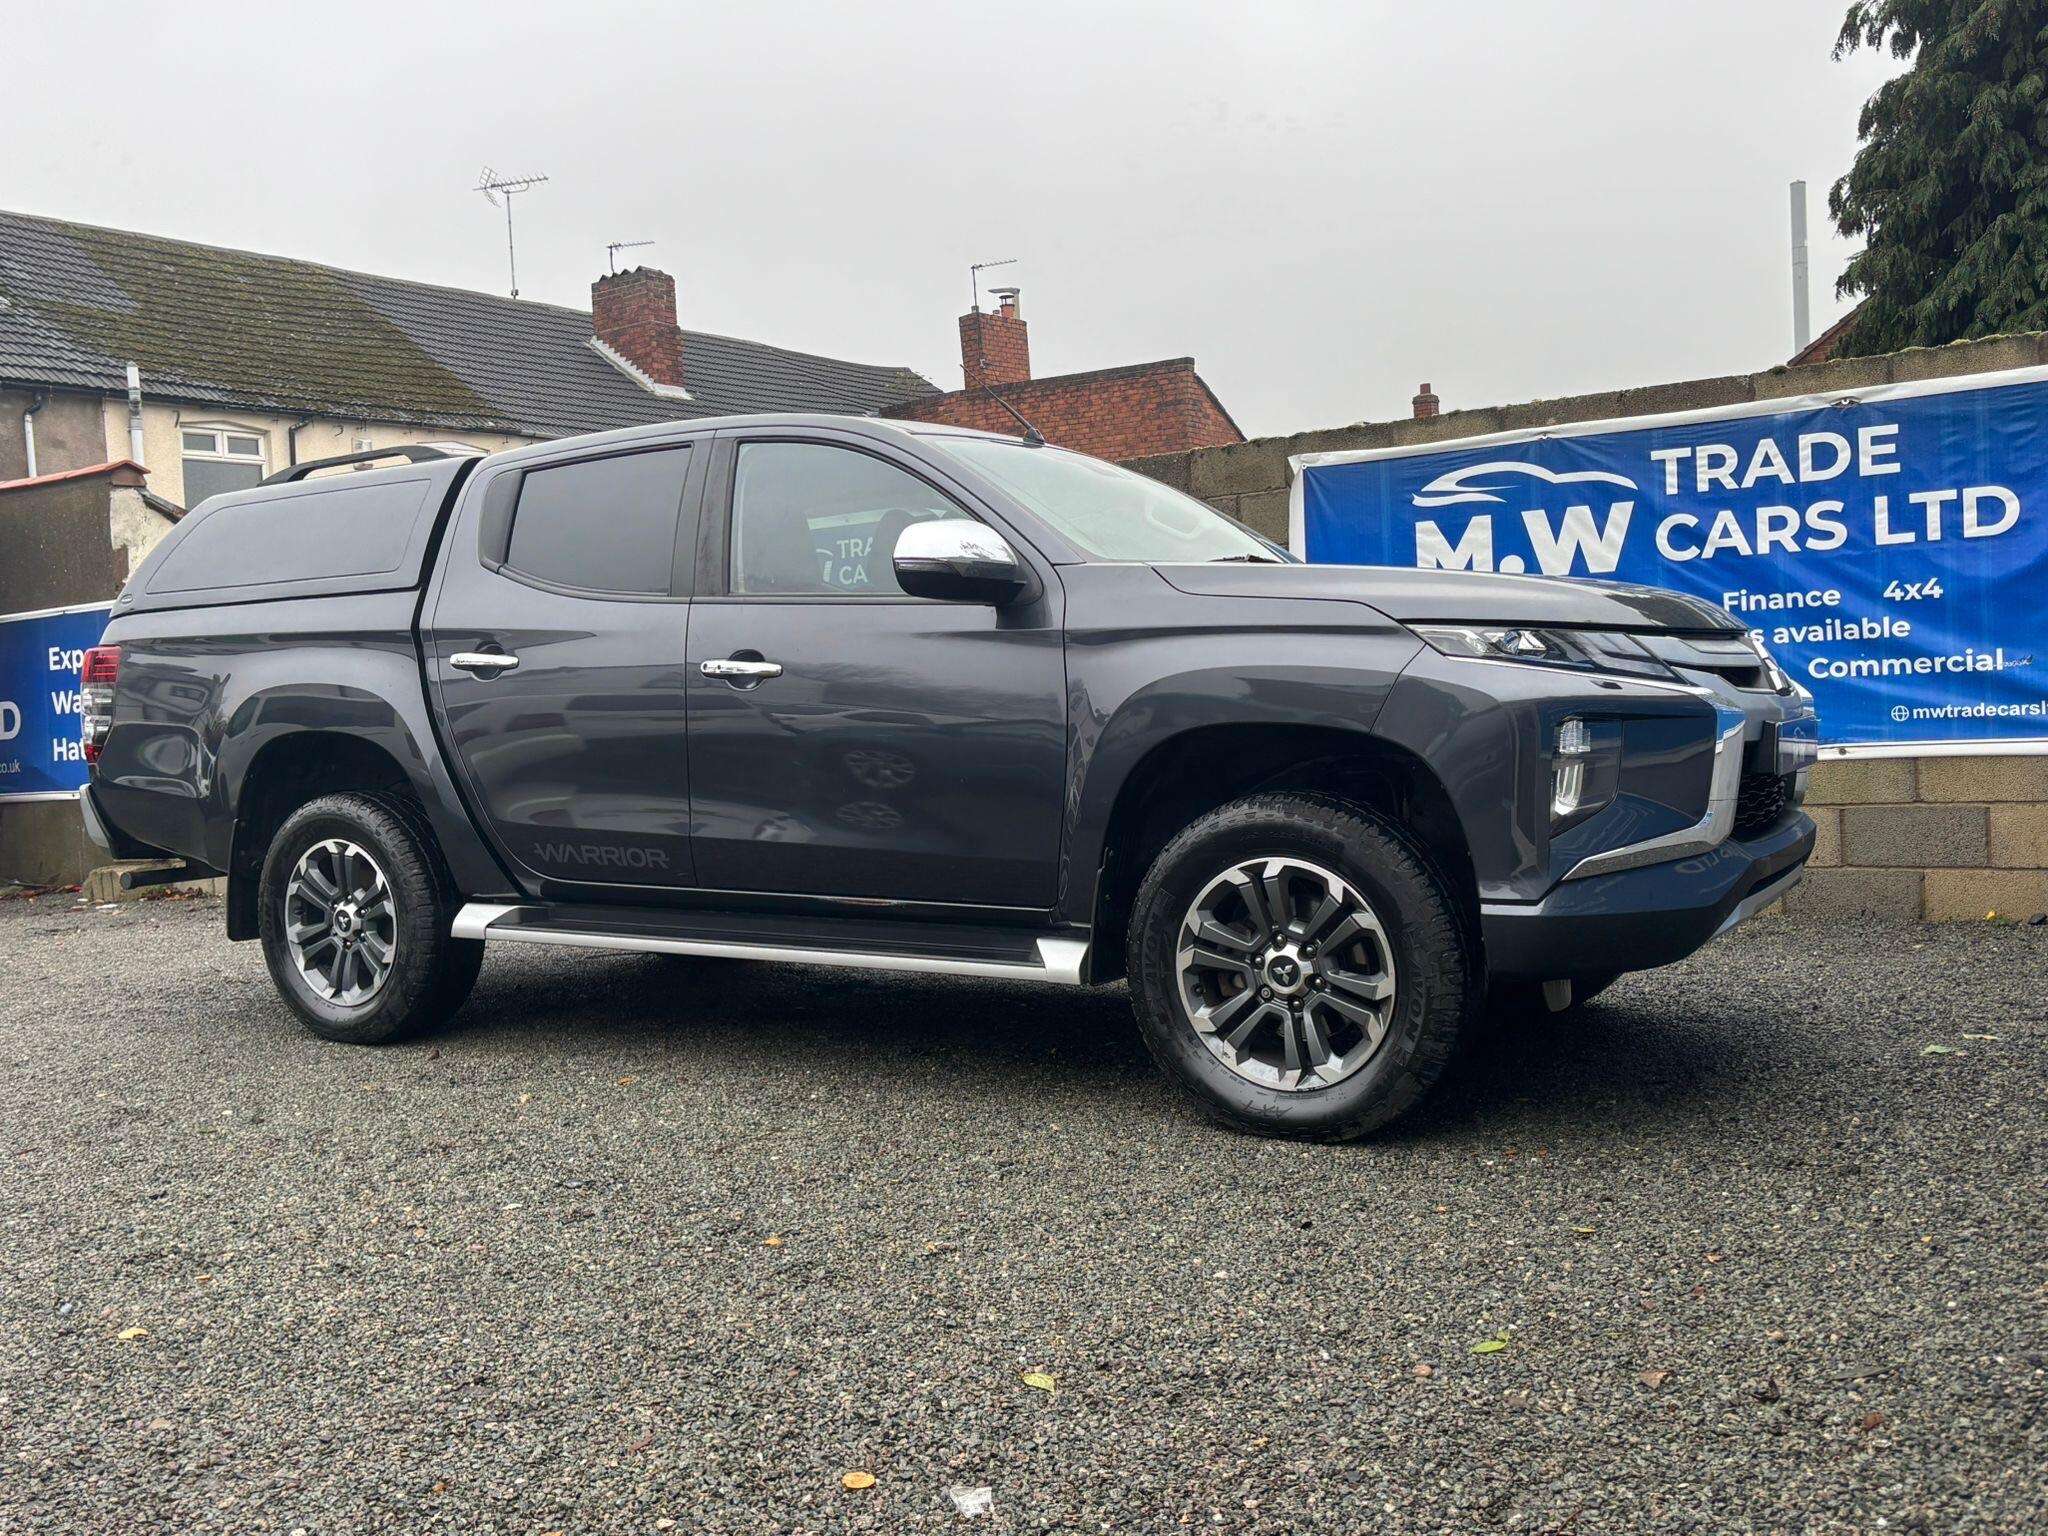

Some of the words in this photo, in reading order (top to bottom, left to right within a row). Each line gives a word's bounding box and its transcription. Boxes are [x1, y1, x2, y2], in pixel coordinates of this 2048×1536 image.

[1650, 423, 1901, 495] TRADE
[1655, 500, 1848, 562] CARS
[1874, 485, 2020, 546] LTD
[1415, 500, 1635, 576] M.W
[839, 564, 868, 584] CA
[1723, 588, 1841, 612] Finance
[1883, 577, 1943, 601] 4x4
[1773, 616, 1911, 644] available
[1808, 648, 2003, 679] Commercial
[1913, 700, 2048, 719] mwtradecarsl
[534, 842, 670, 869] WARRIOR
